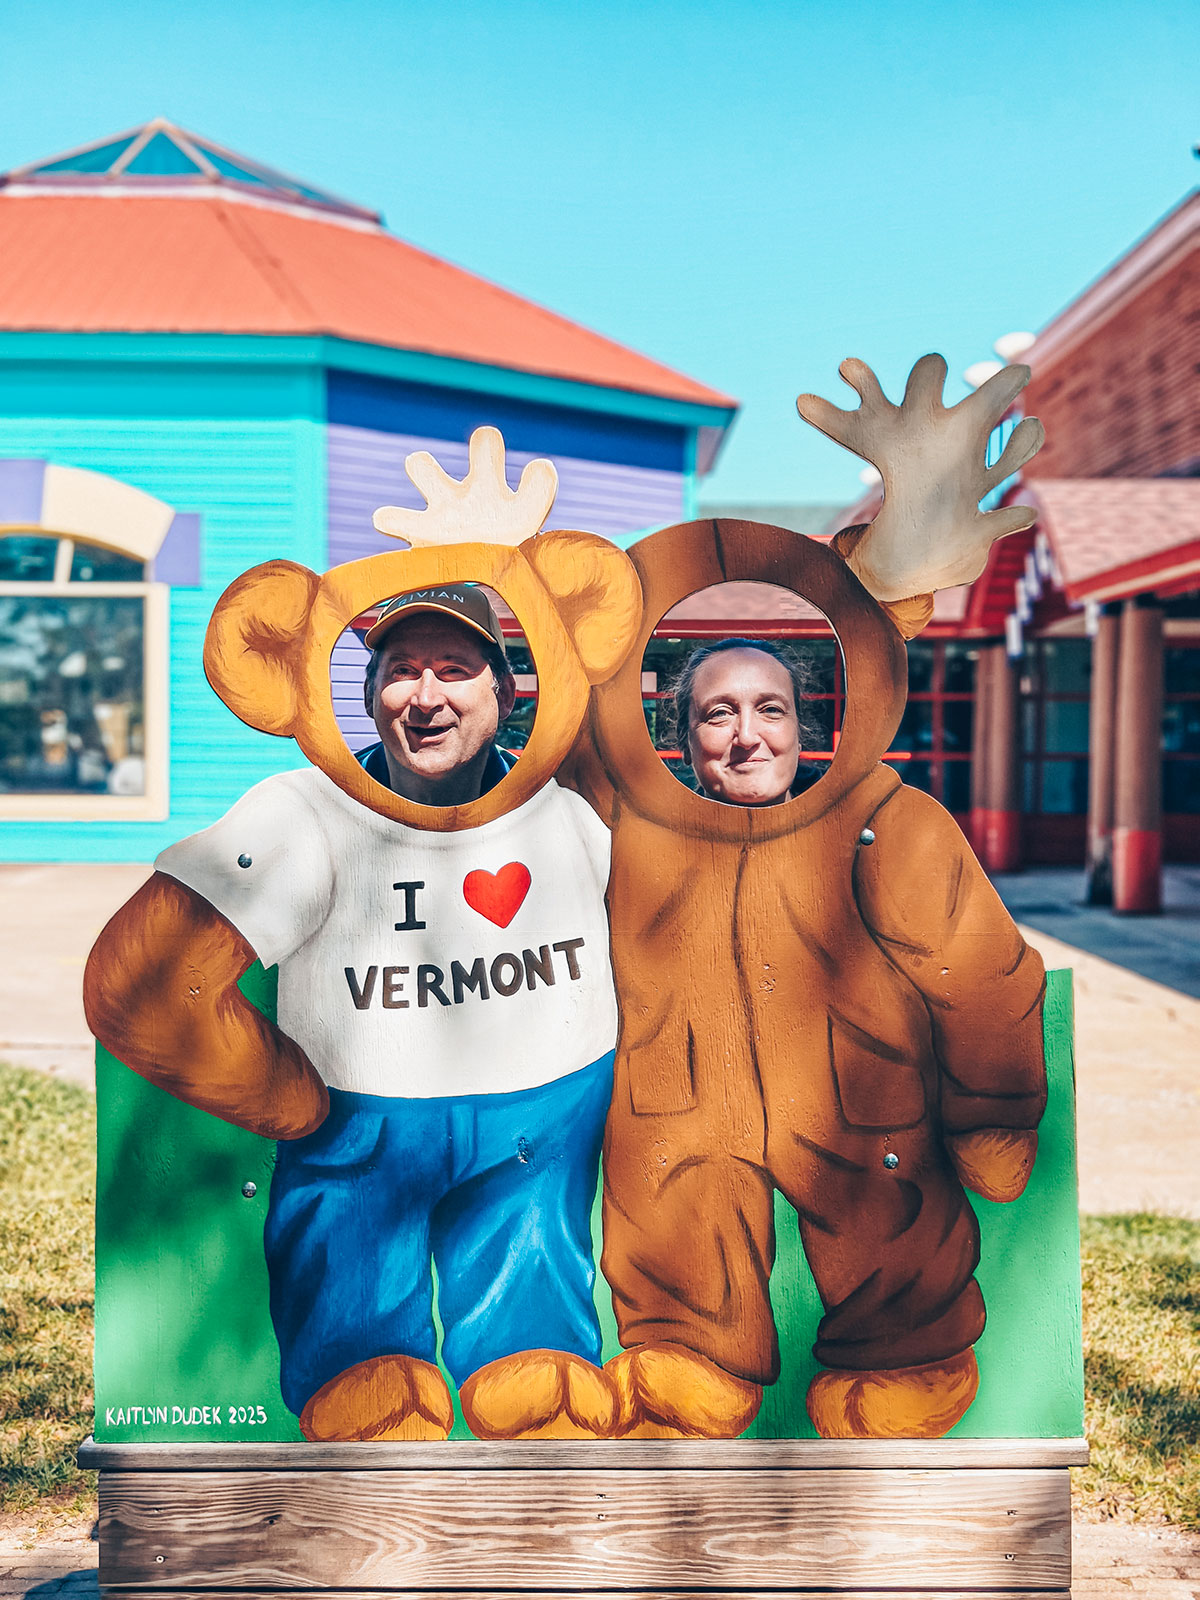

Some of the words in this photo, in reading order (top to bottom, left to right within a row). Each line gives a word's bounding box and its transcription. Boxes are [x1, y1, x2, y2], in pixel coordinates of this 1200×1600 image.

[393, 881, 426, 931] I
[344, 937, 585, 1010] VERMONT
[106, 1406, 168, 1426] KAITLYN
[172, 1406, 221, 1425] DUDEK
[228, 1405, 268, 1425] 2025
